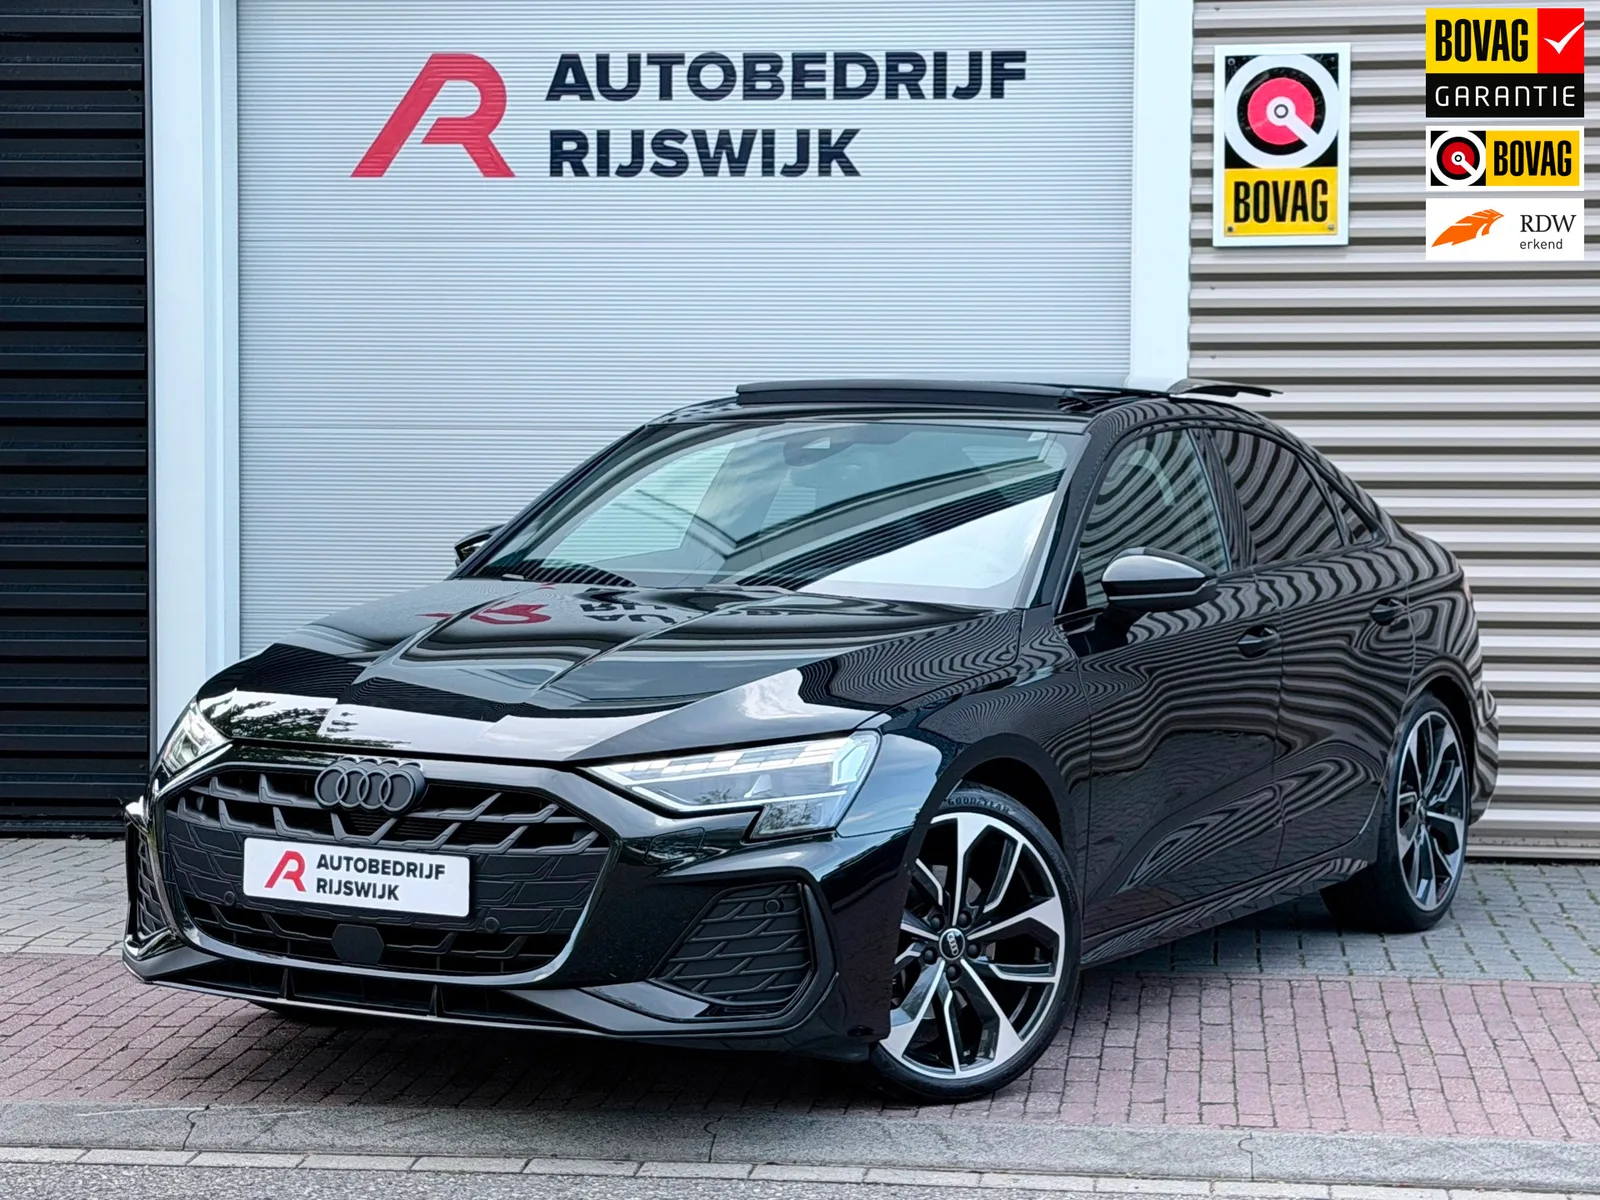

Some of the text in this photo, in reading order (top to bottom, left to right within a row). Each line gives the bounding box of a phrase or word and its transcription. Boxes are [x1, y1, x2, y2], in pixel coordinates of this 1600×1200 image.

[545, 50, 1027, 101] AUTOBEDRIJF
[549, 128, 862, 178] RIJSWIJK
[1232, 178, 1329, 225] BOVAG
[316, 853, 446, 881] AUTOBEDRIJF
[316, 877, 400, 901] RIJSWIJK
